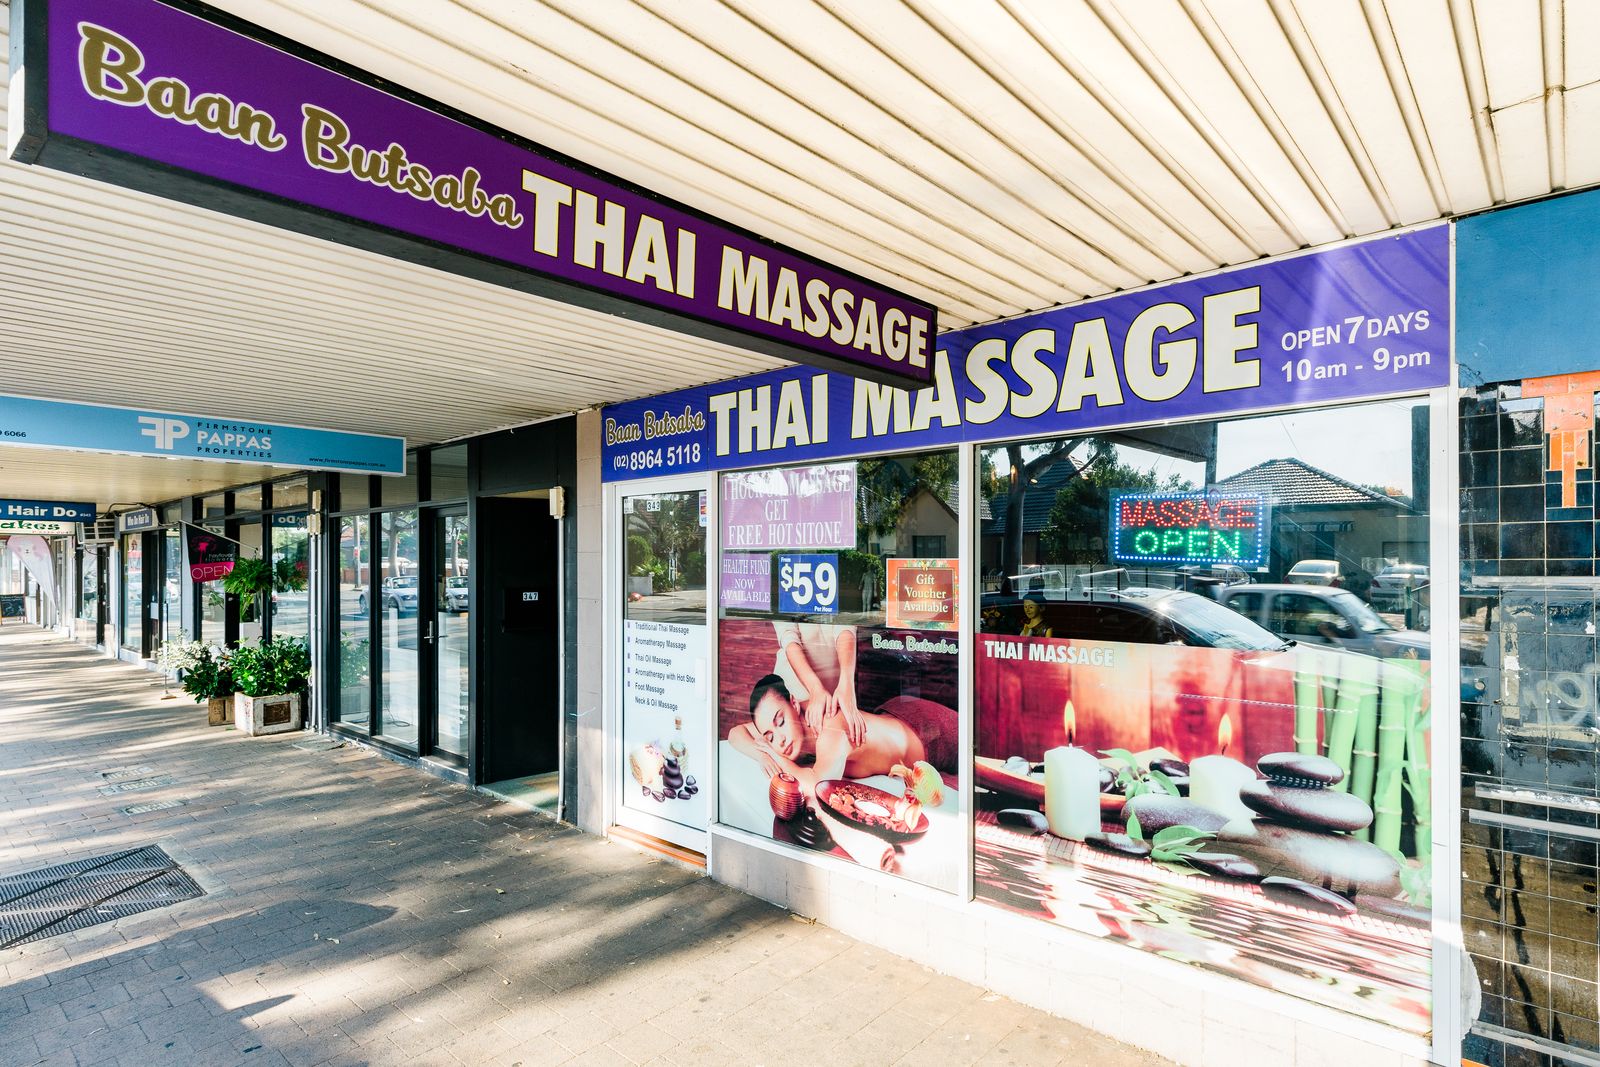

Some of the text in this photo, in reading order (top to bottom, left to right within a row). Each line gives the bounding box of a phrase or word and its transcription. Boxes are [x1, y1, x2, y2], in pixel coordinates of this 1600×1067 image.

[78, 21, 524, 229] Baan Butsaba
[521, 168, 928, 369] THAI MASSAGE
[1281, 310, 1430, 351] OPEN 7 DAYS
[709, 286, 1261, 457] THAI MASSAGE
[1281, 359, 1347, 382] 10am
[1373, 347, 1431, 373] 9pm
[197, 422, 273, 435] FIRMSTONE
[606, 405, 706, 446] Baan Butsaba
[197, 430, 272, 450] PAPPAS
[197, 446, 272, 458] PROPERTIES
[613, 443, 701, 470] (02) 8964 5118
[8, 505, 48, 517] Hair
[53, 507, 77, 517] Do
[765, 499, 788, 521] GET
[1121, 500, 1256, 527] MASSAGE
[728, 524, 763, 545] FREE
[768, 523, 793, 545] HOT
[1135, 530, 1241, 558] OPEN
[191, 565, 234, 580] OPEN
[723, 558, 770, 575] HEALTH FUND
[734, 579, 756, 590] NOW
[780, 562, 837, 606] $59
[916, 573, 935, 585] Gift
[523, 592, 538, 600] 347
[720, 590, 771, 603] AVAILABLE
[904, 585, 947, 599] Voucher
[903, 601, 949, 613] Available
[635, 622, 690, 635] Traditional Thai Massage
[635, 637, 687, 651] Aromatherapy Massage
[872, 633, 958, 654] Baan Butsaba
[635, 653, 644, 661] Thai
[652, 655, 672, 666] Massage
[984, 640, 1115, 667] THAI MASSAGE
[635, 668, 665, 680] Aromatherapy
[666, 672, 676, 681] with
[677, 673, 685, 682] Hot
[635, 682, 665, 695] Foot Massage
[635, 696, 646, 704] Neck
[658, 700, 678, 712] Massage
